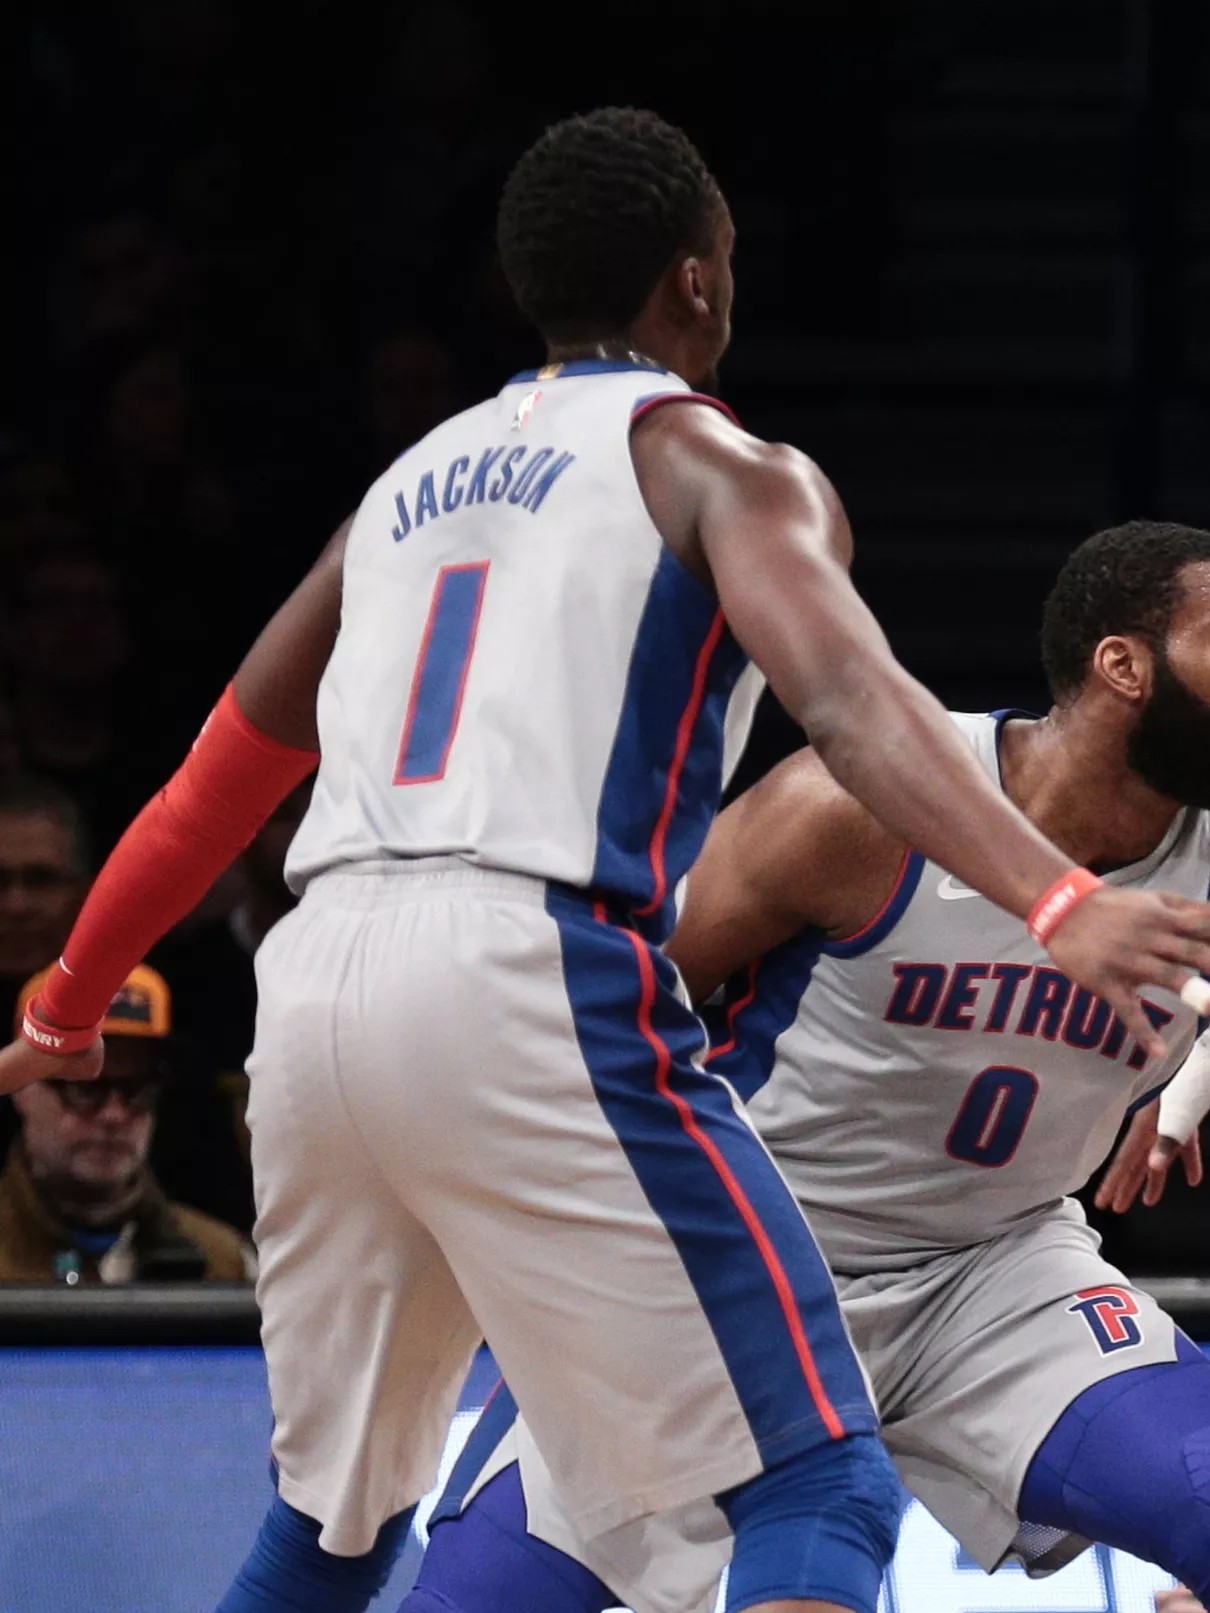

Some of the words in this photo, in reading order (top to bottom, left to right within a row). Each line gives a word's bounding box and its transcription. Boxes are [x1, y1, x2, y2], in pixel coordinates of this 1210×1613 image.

[391, 445, 575, 542] JACKSON
[393, 559, 491, 785] 1
[944, 1064, 1040, 1168] 0
